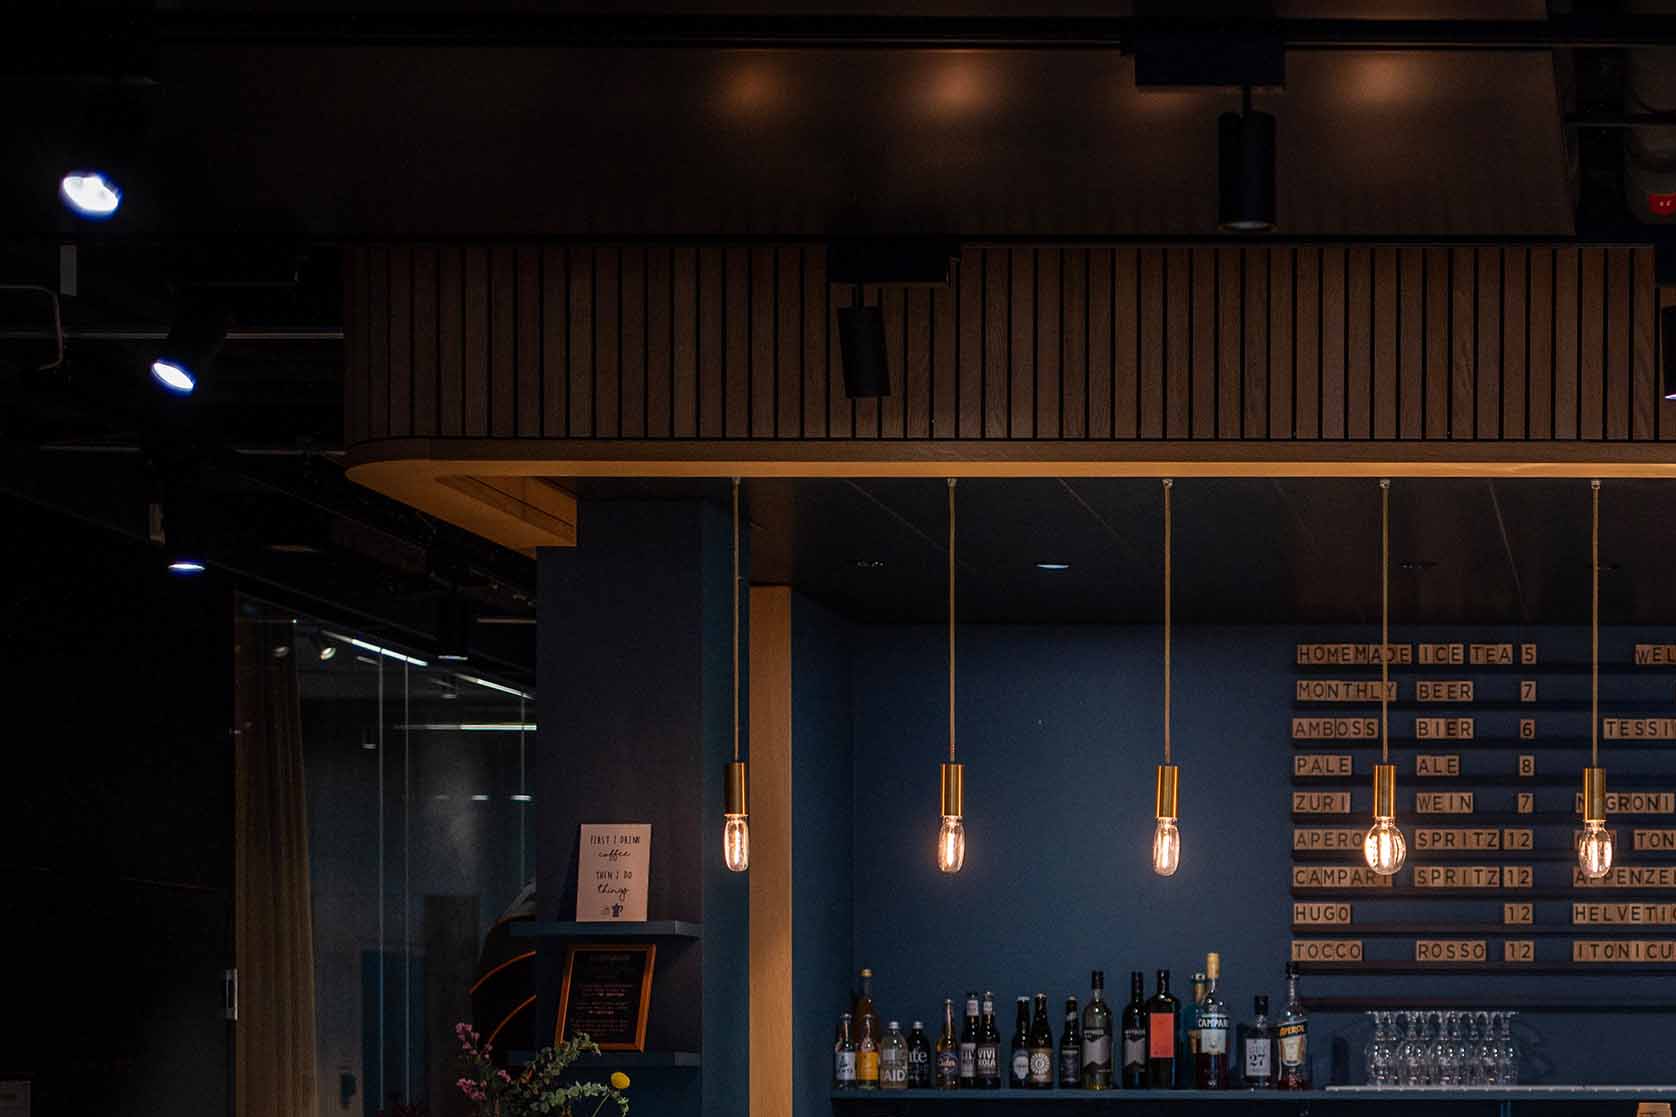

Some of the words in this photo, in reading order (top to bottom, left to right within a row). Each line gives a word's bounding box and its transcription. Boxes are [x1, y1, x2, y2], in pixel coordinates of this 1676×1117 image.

[1424, 648, 1460, 661] ICE
[1474, 648, 1510, 662] TEA
[1525, 648, 1533, 662] 5
[1299, 684, 1394, 697] MONTHLY
[1419, 684, 1471, 698] BEER
[1524, 684, 1533, 698] 7
[1296, 721, 1375, 736] AMBOSS
[1419, 722, 1471, 736] BIER
[1524, 722, 1532, 736] 6
[1298, 758, 1349, 773] PALE
[1419, 759, 1457, 773] ALE
[1523, 760, 1531, 773] 8
[1296, 796, 1348, 810] ZURI
[1418, 796, 1471, 810] WEIN
[1521, 796, 1530, 810] 7
[1577, 797, 1671, 811] NGRONI
[1296, 834, 1363, 847] APERO
[1418, 834, 1497, 847] SPRITZ
[1508, 834, 1530, 847] 12
[1418, 870, 1497, 885] SPRITZ
[1508, 871, 1530, 885] 12
[1296, 908, 1348, 921] HUGO
[1508, 908, 1530, 921] 12
[1295, 944, 1360, 959] TOCCO
[1418, 944, 1484, 959] ROSSO
[1508, 944, 1530, 959] 12
[1198, 1019, 1229, 1027] CAMPAR
